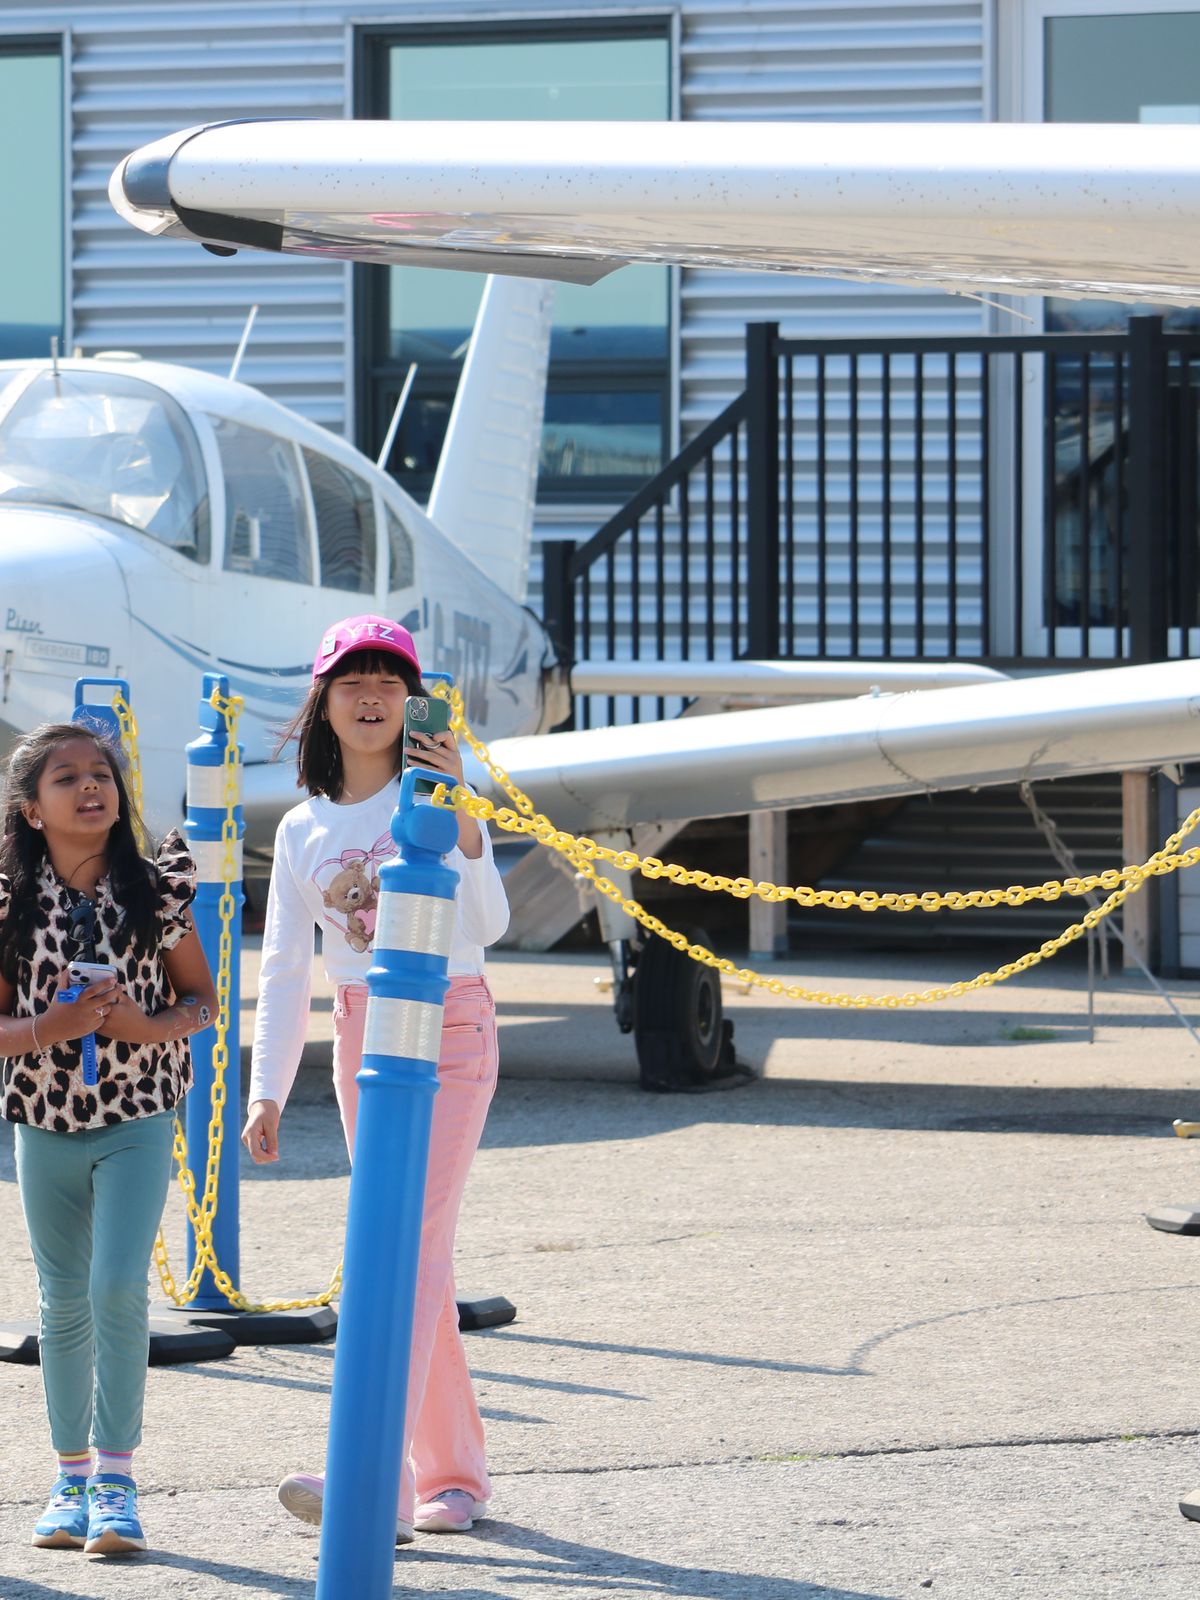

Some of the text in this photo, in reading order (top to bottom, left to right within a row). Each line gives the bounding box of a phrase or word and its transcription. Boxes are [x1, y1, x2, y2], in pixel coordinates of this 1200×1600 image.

[5, 607, 44, 634] Piper
[345, 623, 395, 641] YTZ
[30, 641, 83, 660] CHEROKEE
